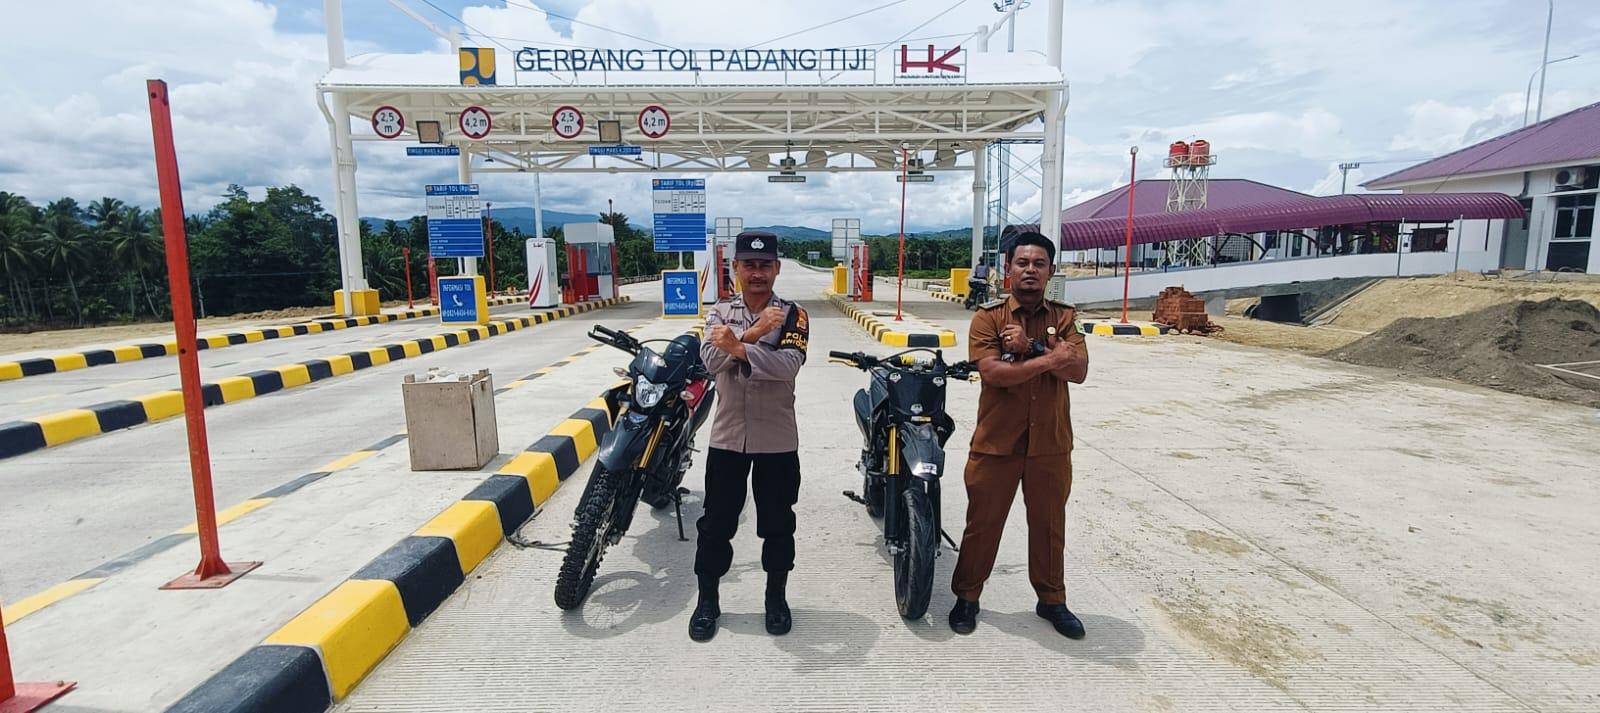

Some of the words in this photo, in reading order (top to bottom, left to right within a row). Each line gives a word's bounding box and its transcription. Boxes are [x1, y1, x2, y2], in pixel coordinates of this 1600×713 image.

[516, 48, 645, 71] GERBANG
[652, 48, 702, 71] TOL
[710, 48, 817, 71] PADANG
[823, 48, 867, 71] TIJI
[901, 44, 961, 73] HK
[380, 112, 395, 122] 2,5
[561, 112, 575, 122] 2,5
[465, 117, 478, 128] 4,2
[479, 119, 487, 127] m
[643, 117, 656, 128] 4,2
[657, 118, 666, 126] m
[384, 125, 393, 133] m
[564, 125, 573, 133] m
